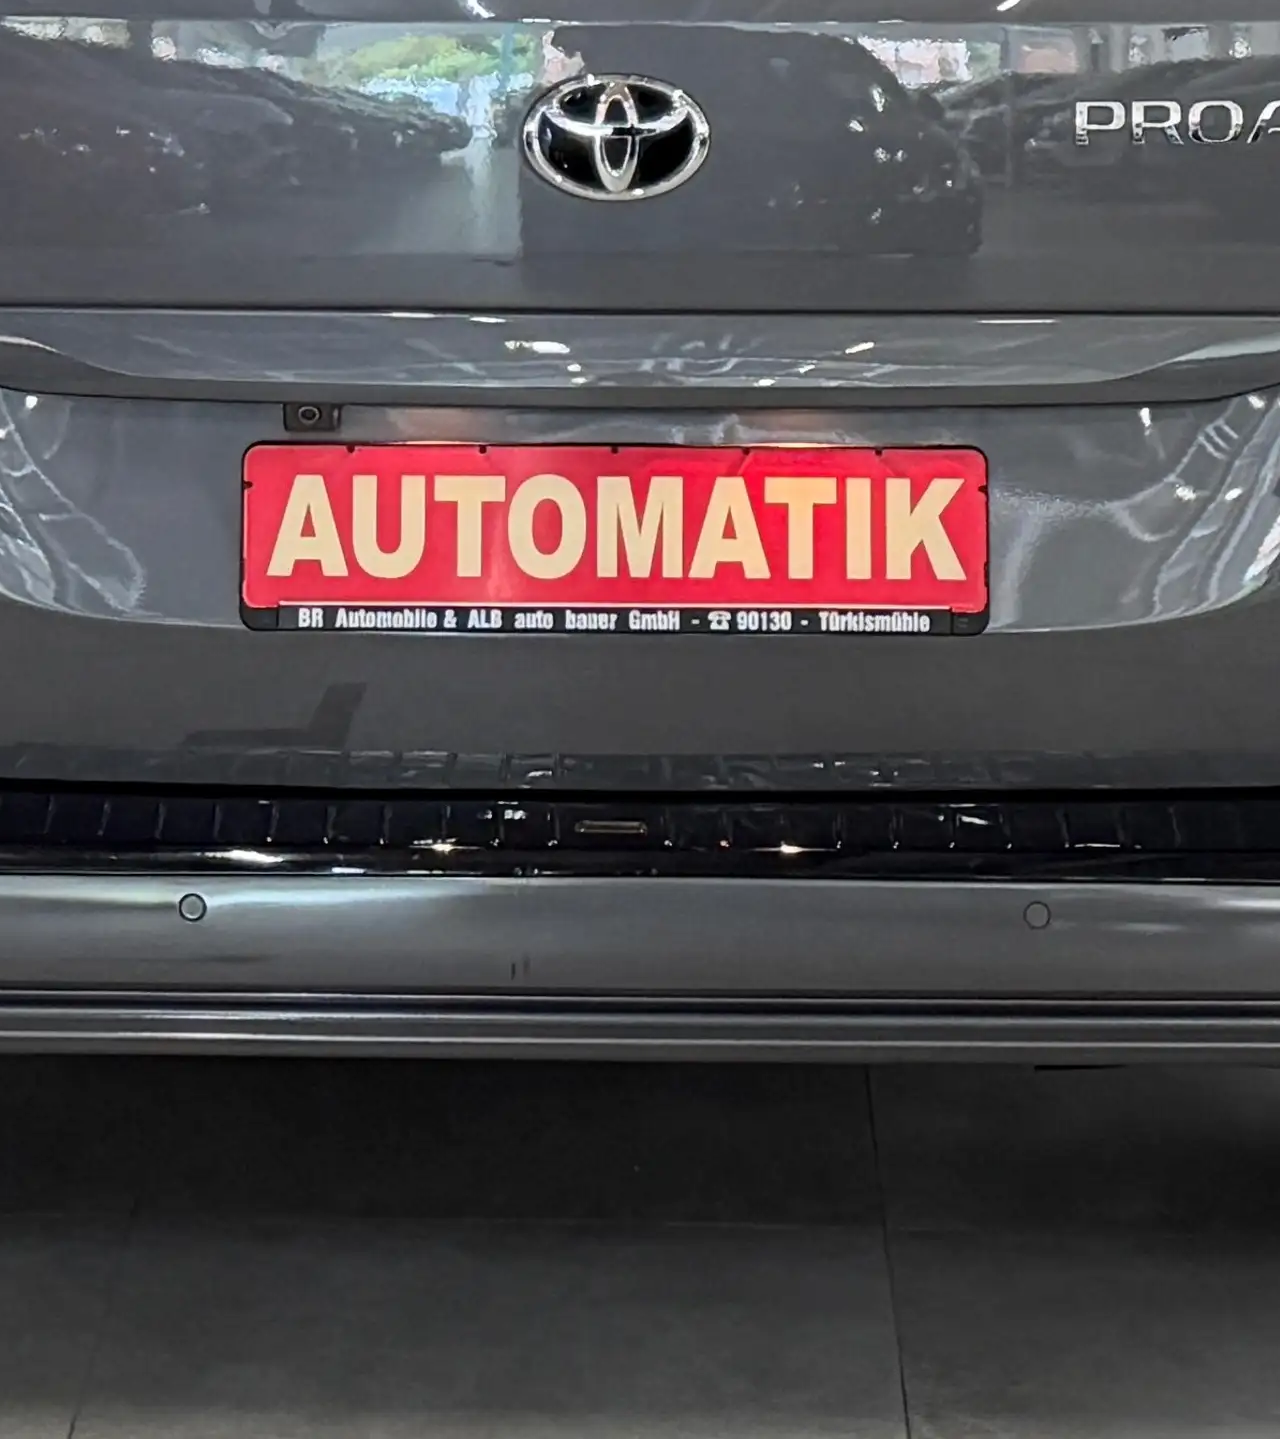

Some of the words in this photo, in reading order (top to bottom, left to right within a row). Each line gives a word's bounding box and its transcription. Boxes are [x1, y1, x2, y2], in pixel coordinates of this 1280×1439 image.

[267, 473, 967, 582] AUTOMATIK
[297, 607, 324, 628] BR
[335, 607, 437, 629] Automobile
[443, 609, 457, 628] &
[467, 609, 503, 629] ALB
[514, 609, 554, 630] auto
[565, 609, 618, 630] bauer
[628, 609, 681, 630] GmbH
[736, 610, 793, 631] 90130
[818, 610, 931, 633] Türkismühle
